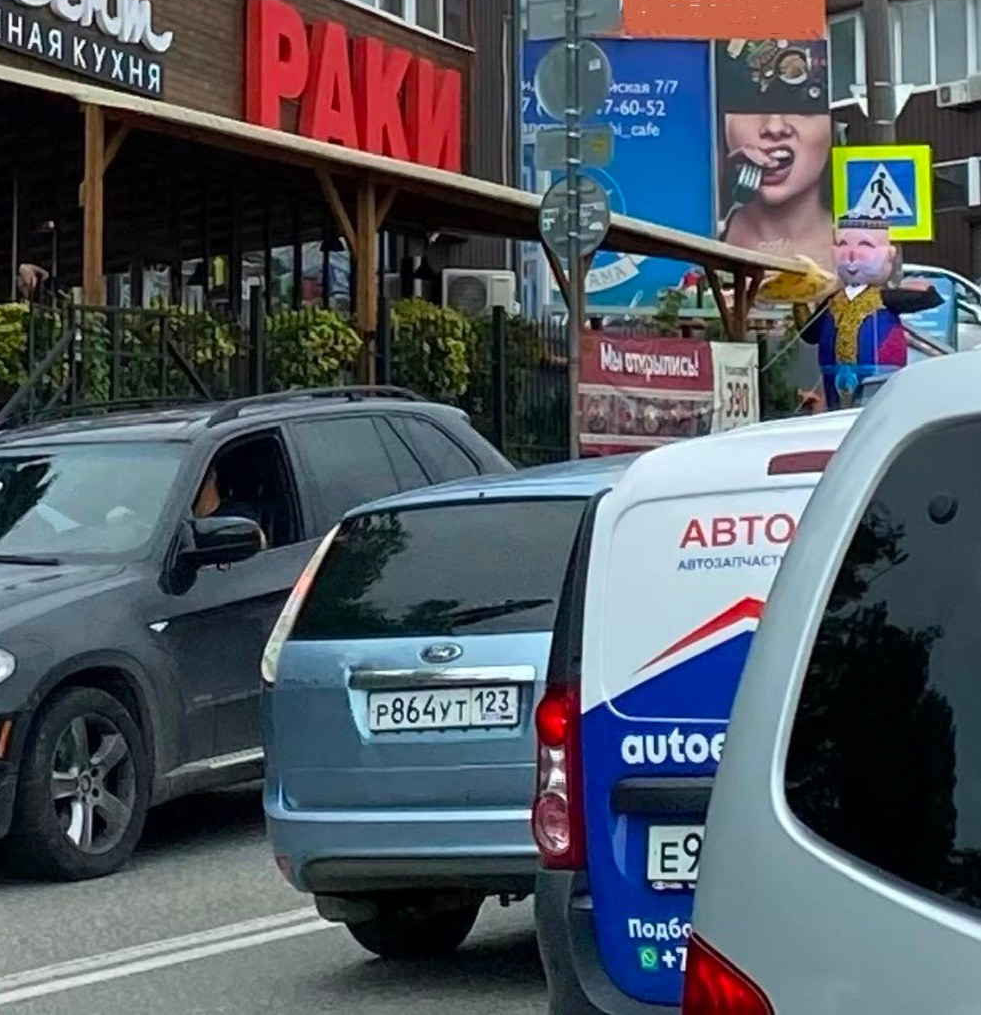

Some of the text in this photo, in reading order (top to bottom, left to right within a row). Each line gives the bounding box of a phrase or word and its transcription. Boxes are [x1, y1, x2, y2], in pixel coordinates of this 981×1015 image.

[72, 36, 162, 94] КУХНЯ
[679, 513, 797, 548] АВТО
[376, 690, 509, 726] Р864УТ 123
